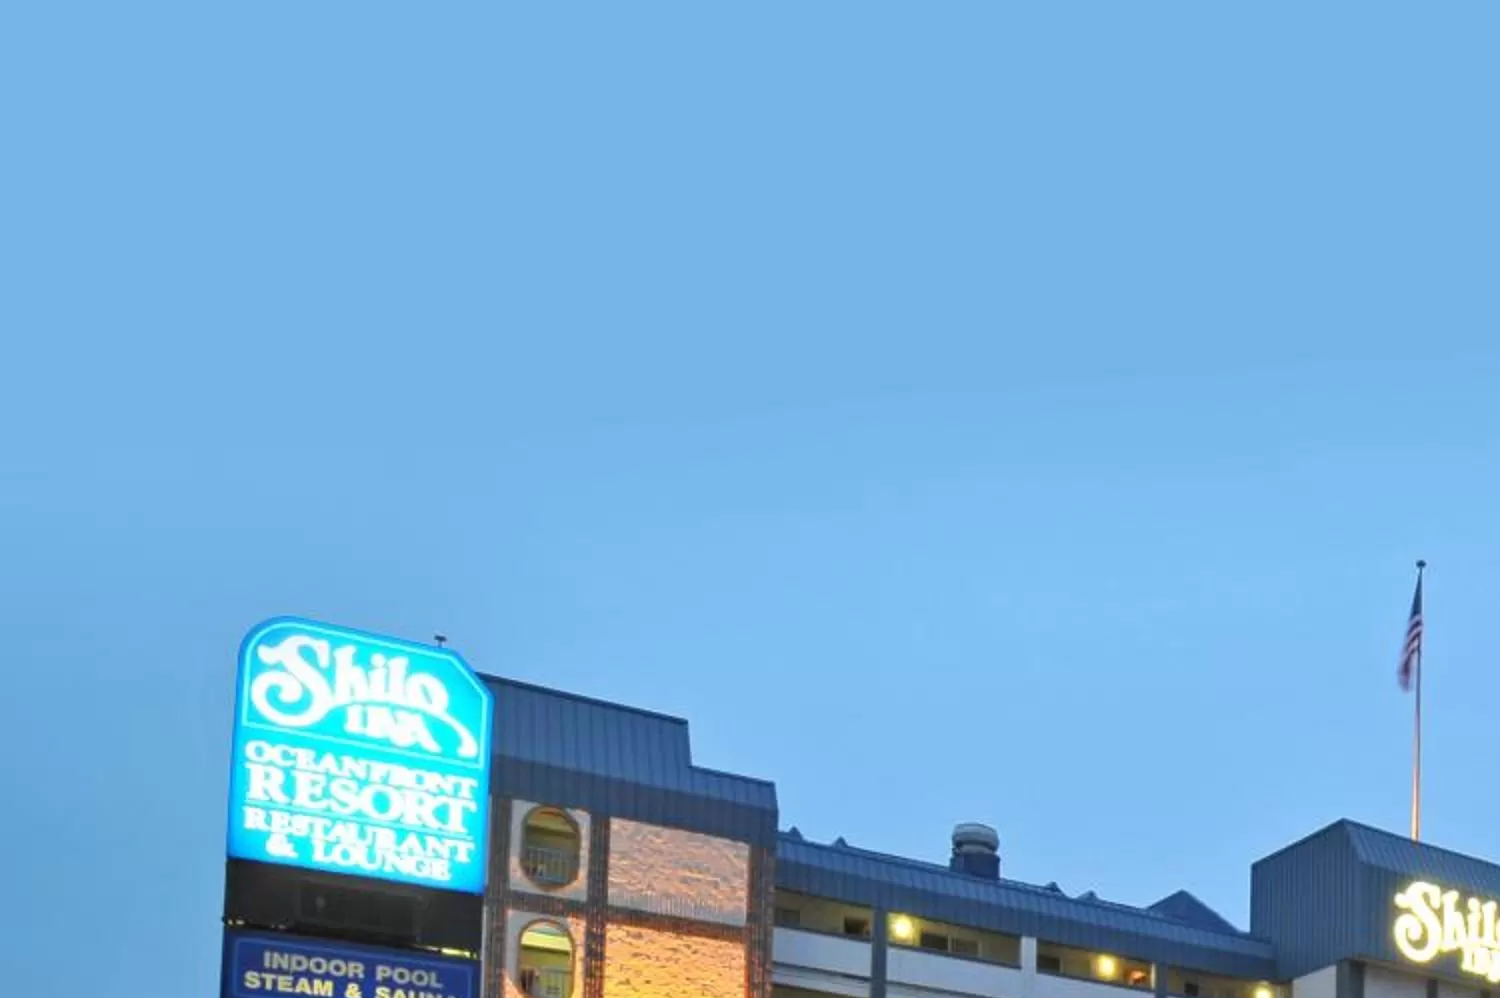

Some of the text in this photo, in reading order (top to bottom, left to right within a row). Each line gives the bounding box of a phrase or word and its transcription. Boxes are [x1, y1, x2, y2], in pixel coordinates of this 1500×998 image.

[251, 635, 478, 757] Shilo
[245, 762, 477, 833] RESORT
[246, 740, 478, 799] OCEANFRONT
[244, 806, 474, 863] RESTAURANT
[265, 834, 451, 881] & LOUNGE
[244, 971, 333, 997] STEAM
[263, 951, 444, 989] INDOOR POOL
